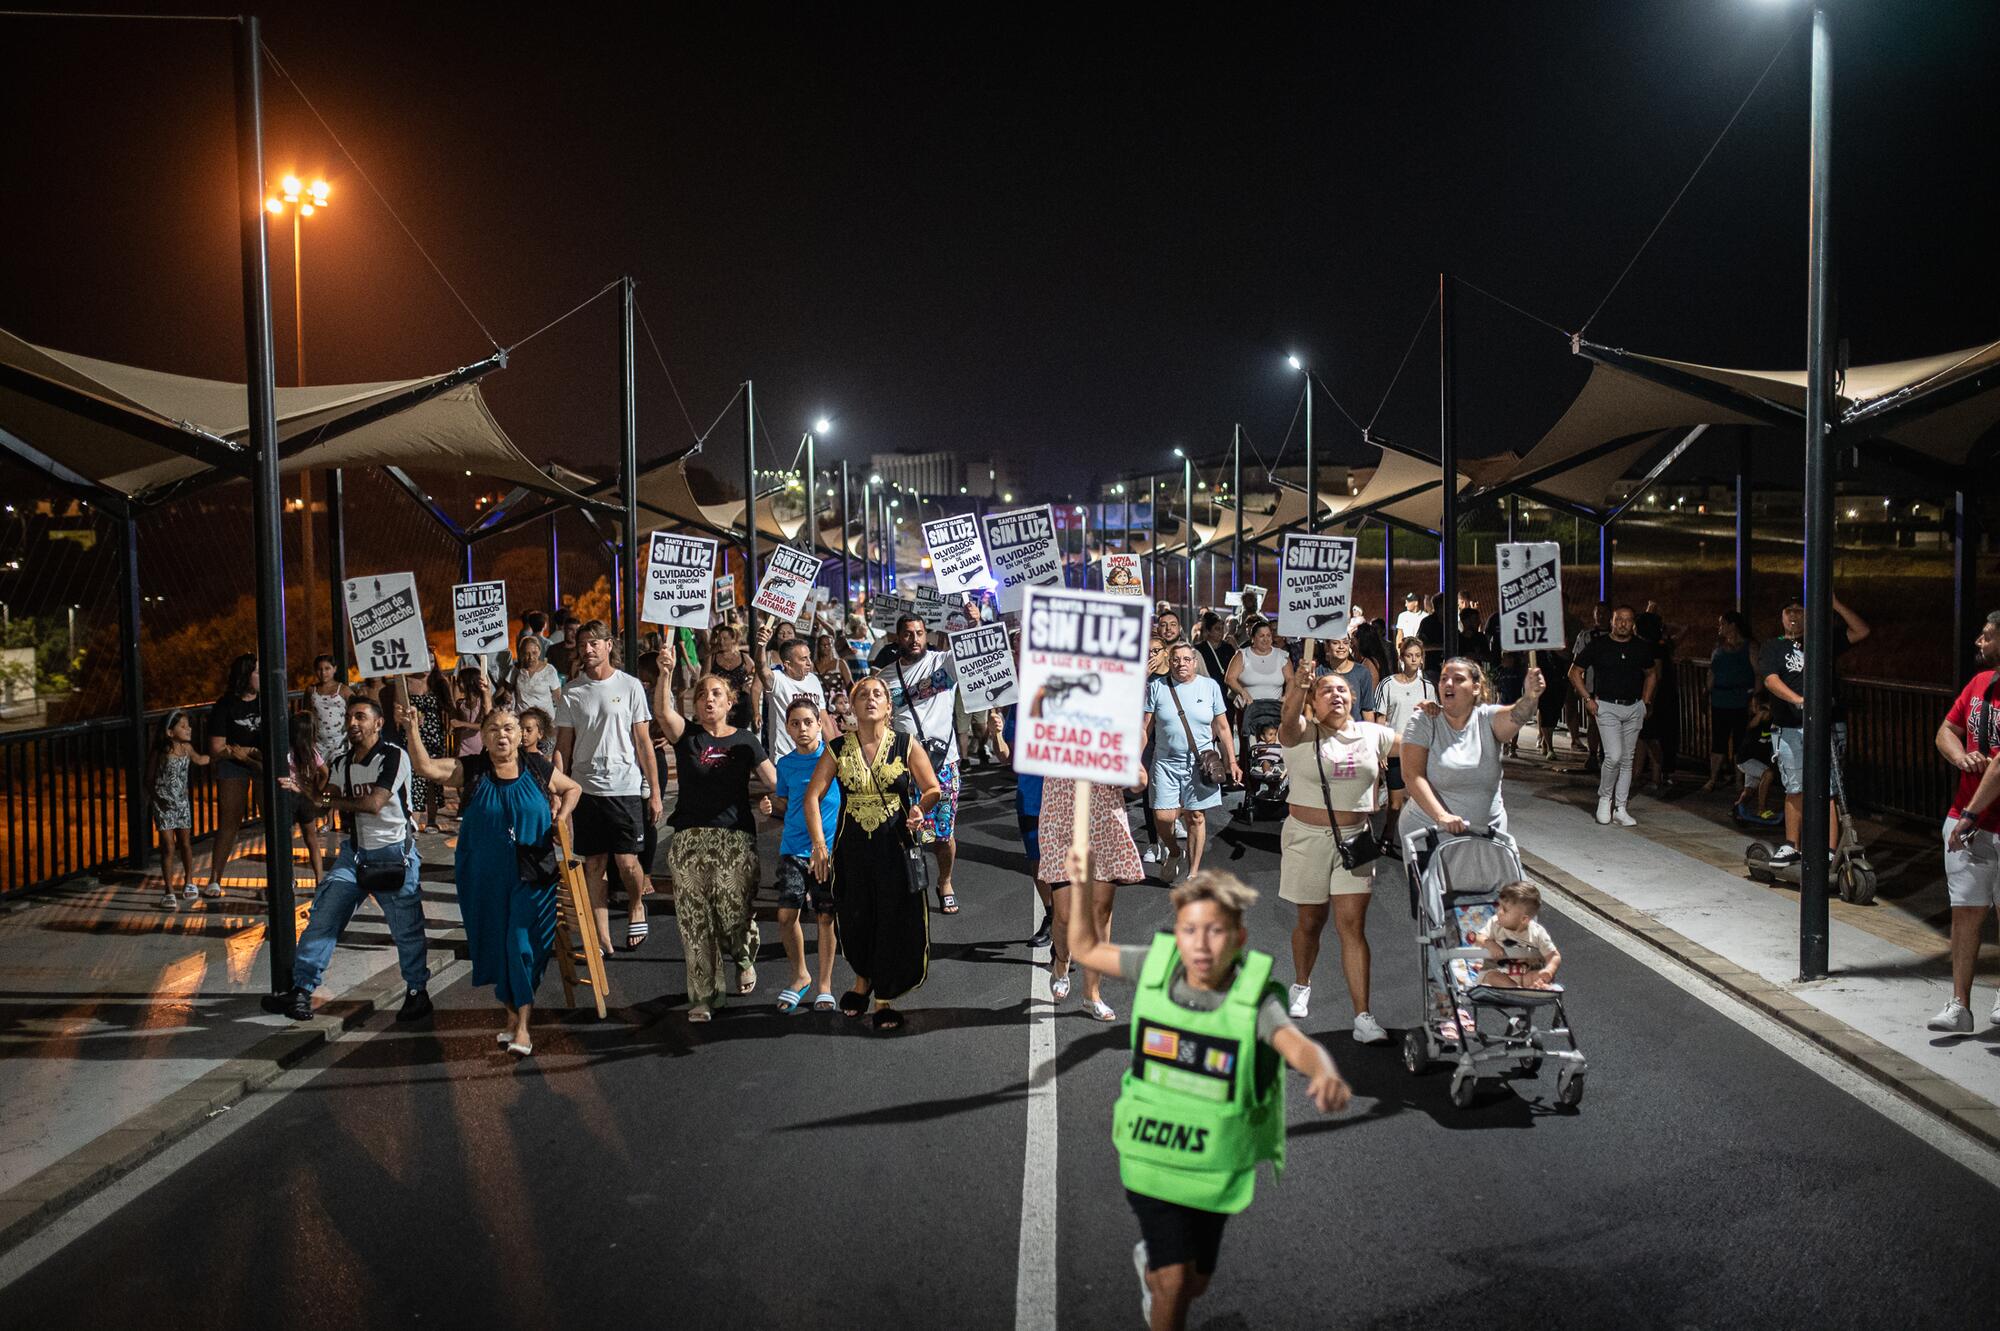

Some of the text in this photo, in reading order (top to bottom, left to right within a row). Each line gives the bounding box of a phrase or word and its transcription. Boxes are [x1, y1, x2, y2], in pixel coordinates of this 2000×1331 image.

[998, 513, 1038, 525] SANTA ISABEL
[665, 538, 683, 546] SANTA
[928, 522, 975, 546] SIN LUZ
[991, 517, 1050, 546] SIN LUZ
[654, 543, 711, 567] SIN LUZ
[934, 538, 974, 559] OLVIDADOS
[996, 540, 1049, 565] OLVIDADOS
[1289, 546, 1349, 570] SIN LUZ
[653, 569, 706, 578] OLVIDADOS
[774, 553, 815, 578] SIN LUZ
[941, 554, 982, 576] SAN JUAN!
[1004, 560, 1057, 587] SAN JUAN!
[1287, 572, 1344, 587] OLVIDADOS
[1502, 583, 1519, 597] San
[1520, 572, 1538, 588] Juan
[457, 589, 501, 606] SIN LUZ
[654, 590, 706, 600] SAN JUAN!
[763, 591, 796, 609] DEJAD DE
[918, 589, 930, 600] SIN
[931, 591, 946, 602] LUZ
[1123, 587, 1141, 595] LUZ
[352, 596, 404, 628] San Juan de
[459, 605, 500, 621] OLVIDADOS
[757, 597, 796, 617] MATARNOS!
[1289, 595, 1345, 611] SAN JUAN!
[356, 605, 414, 640] Aznalfarache
[462, 620, 504, 637] SAN JUAN!
[955, 632, 1005, 657] SIN LUZ
[1031, 610, 1140, 658] SIN LUZ
[1514, 627, 1548, 644] LUZ
[371, 654, 411, 671] LUZ
[960, 651, 1004, 674] OLVIDADOS
[1033, 653, 1046, 664] LA
[1052, 656, 1072, 668] LUZ
[1078, 657, 1091, 670] ES
[967, 668, 1011, 692] SAN JUAN!
[1034, 723, 1122, 750] DEJAD DE
[1026, 743, 1128, 773] MATARNOS!
[1132, 1116, 1210, 1154] ICONS
